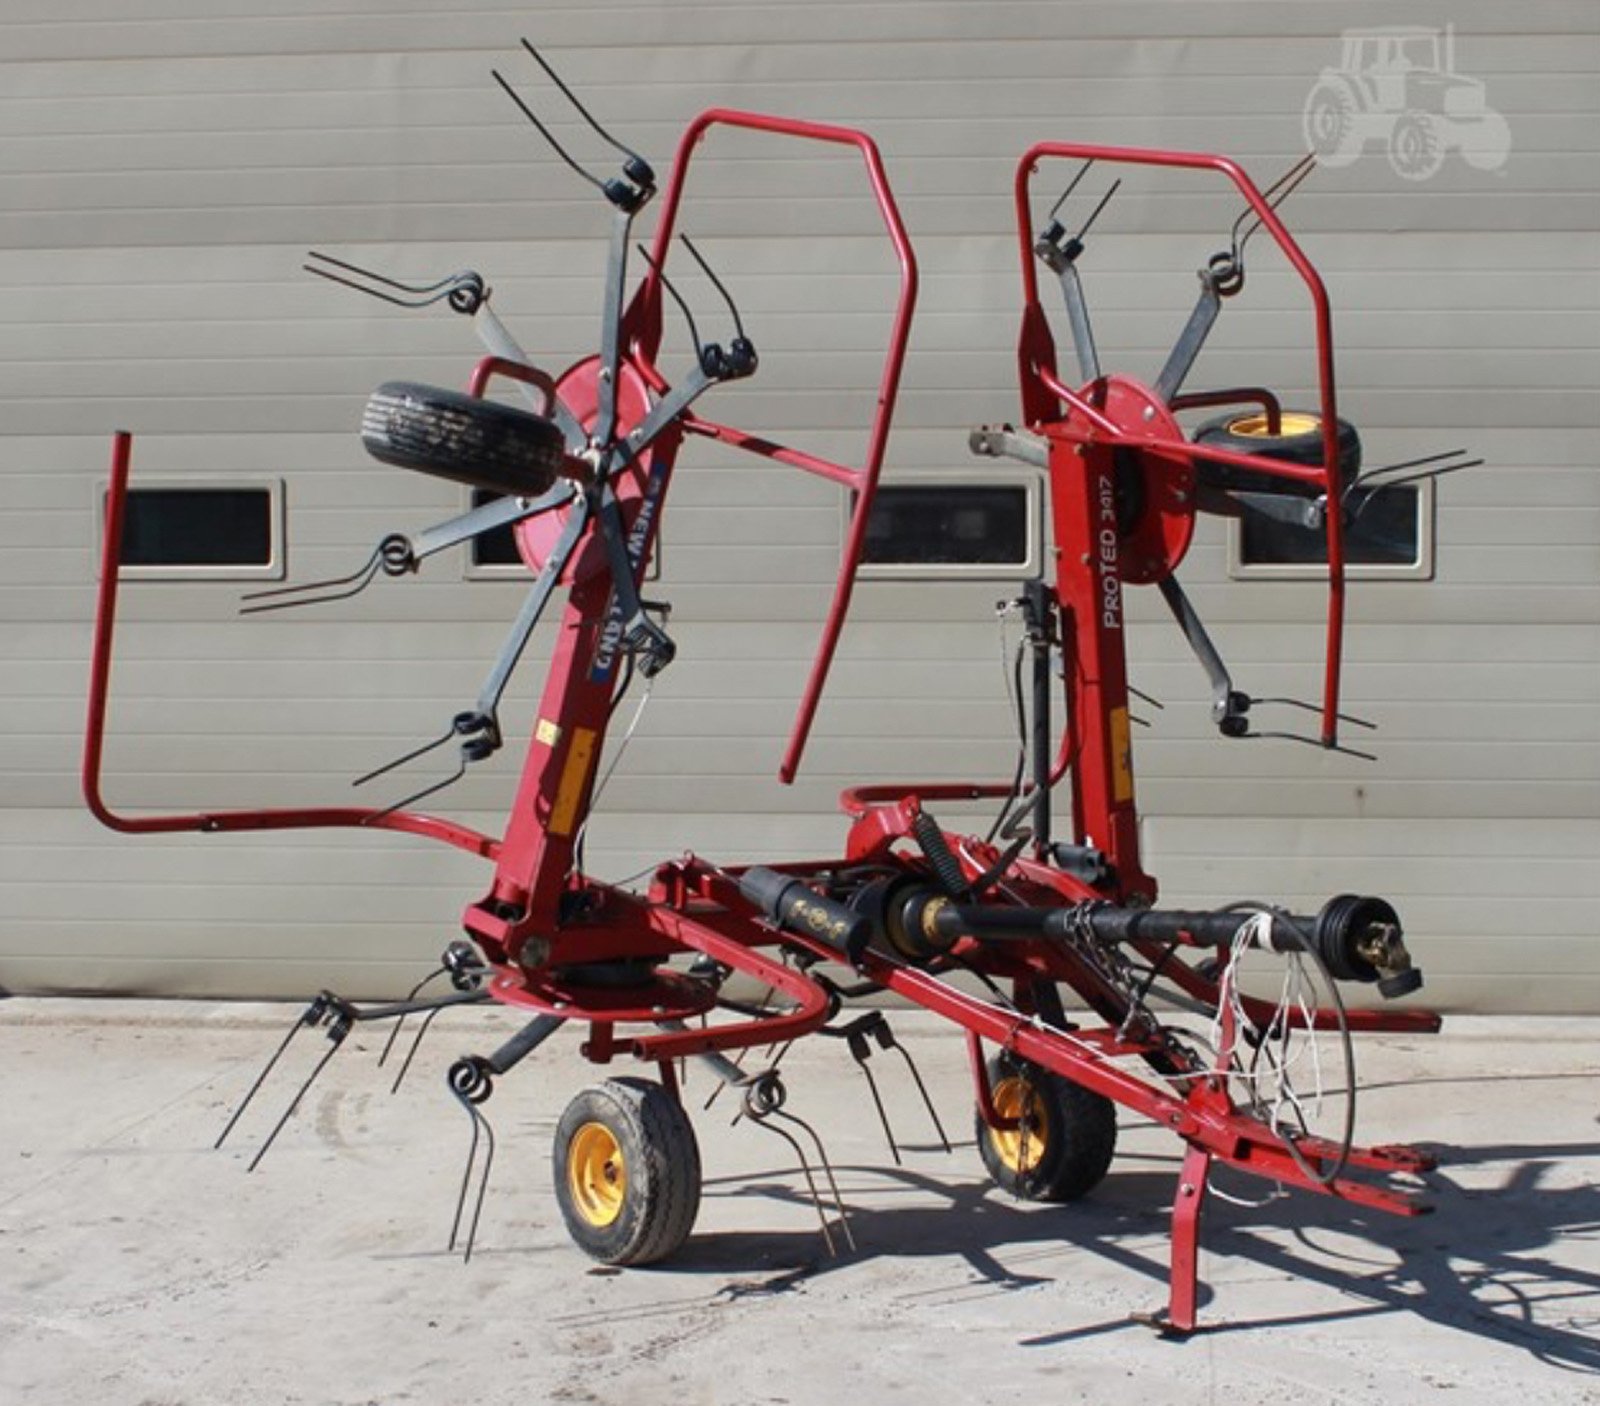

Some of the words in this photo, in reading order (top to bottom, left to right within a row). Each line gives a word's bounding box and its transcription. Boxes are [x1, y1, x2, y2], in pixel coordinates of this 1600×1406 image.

[1099, 475, 1115, 521] 3417
[627, 500, 655, 556] NEW
[1100, 529, 1120, 629] PROTED
